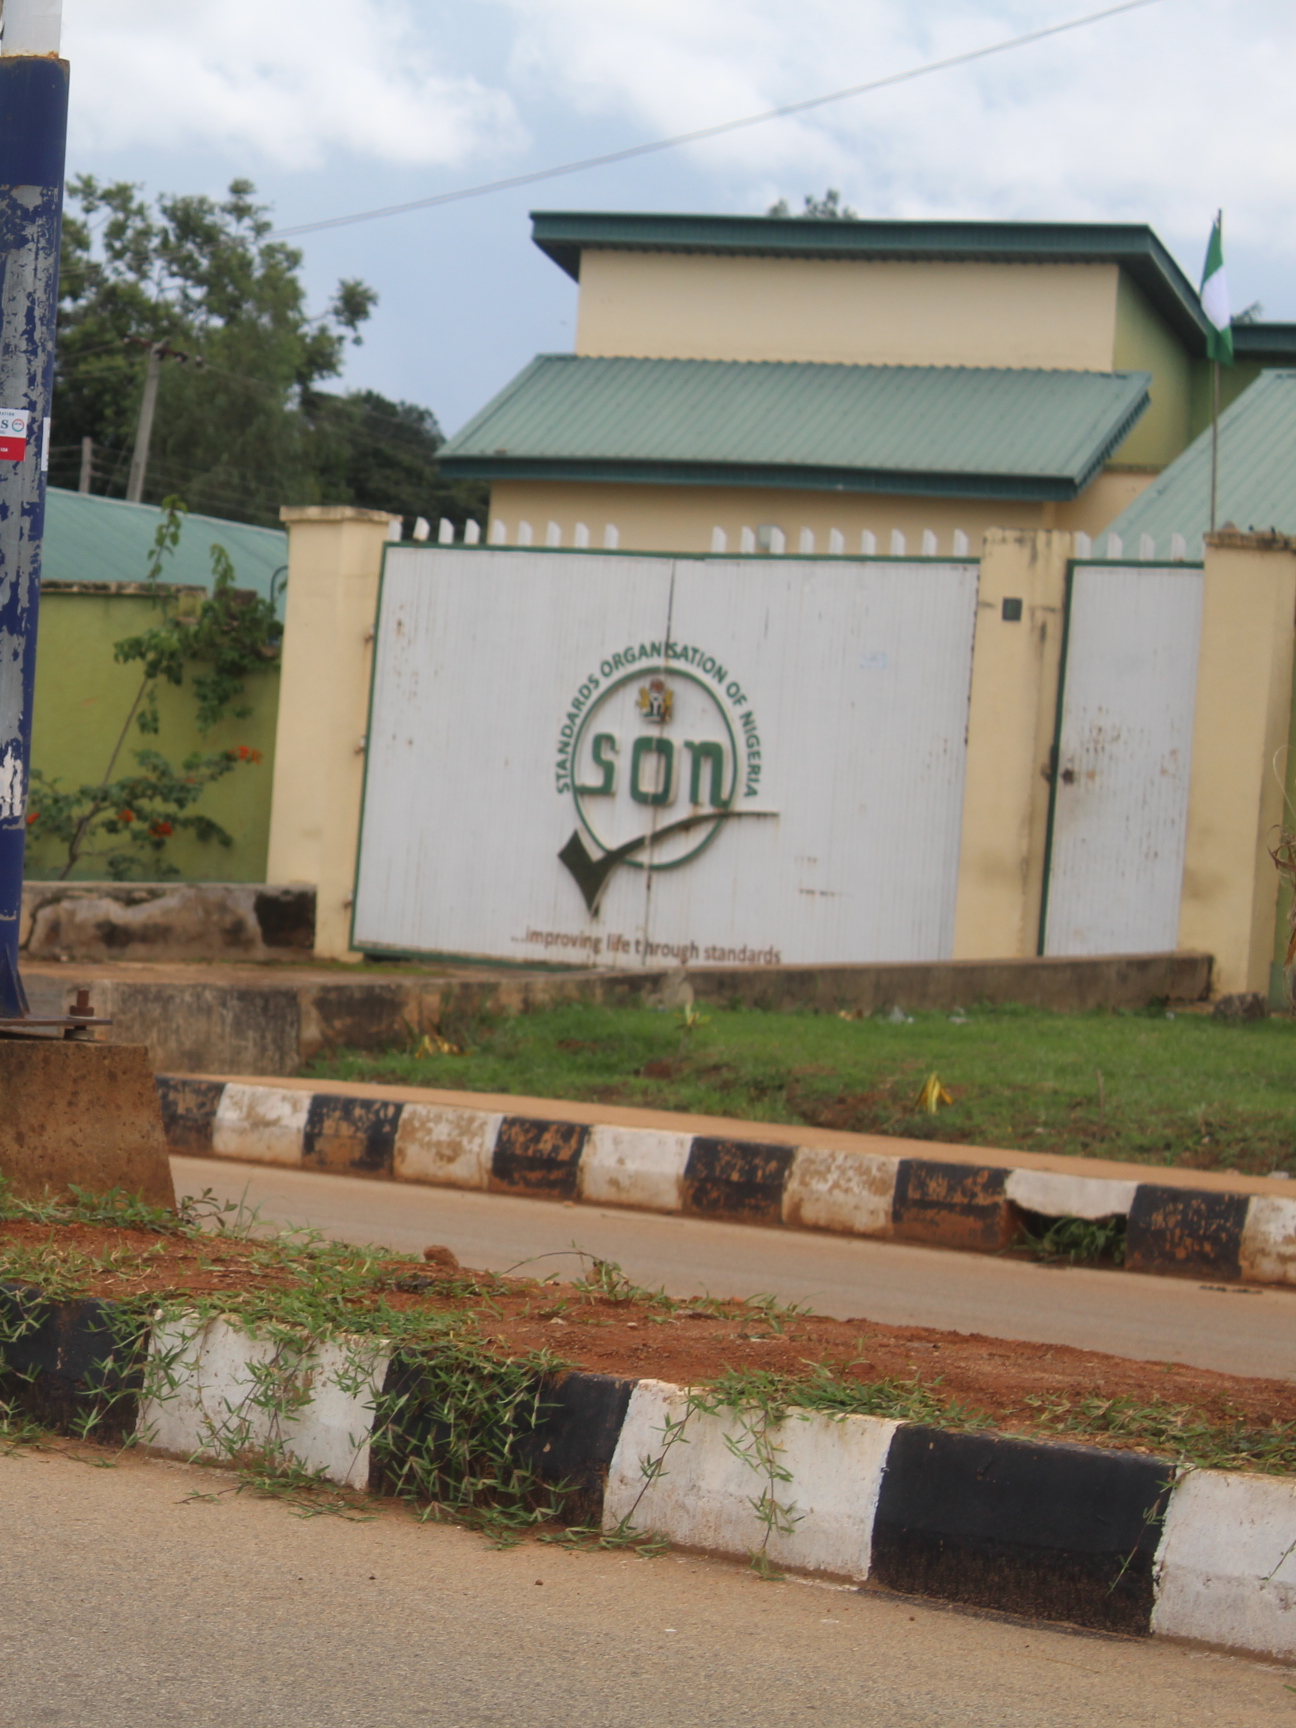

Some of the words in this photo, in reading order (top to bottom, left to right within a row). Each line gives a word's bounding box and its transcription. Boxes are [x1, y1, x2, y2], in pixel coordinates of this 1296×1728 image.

[556, 674, 600, 794] STANDARDS
[600, 640, 728, 685] ORGANISATION
[725, 681, 748, 707] OF
[739, 710, 762, 799] NIGERIA
[607, 932, 630, 954] life
[635, 937, 700, 965] through
[703, 944, 782, 965] standards
